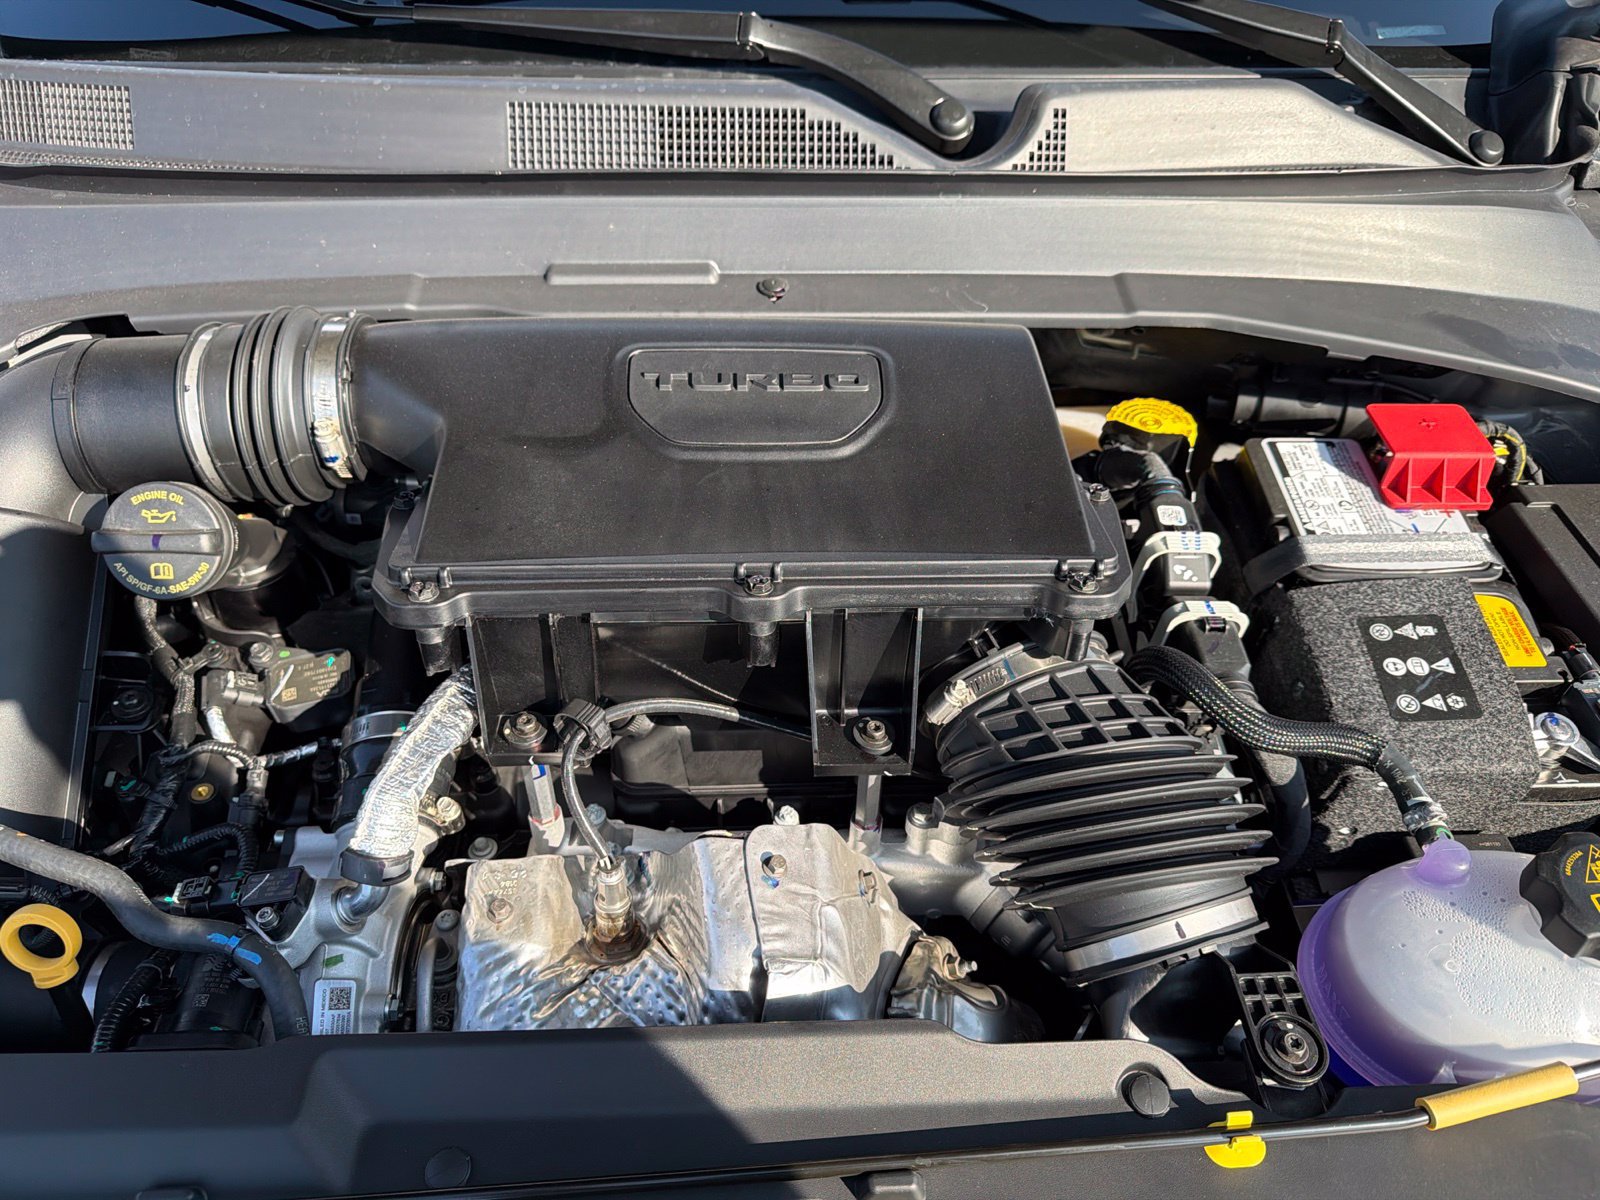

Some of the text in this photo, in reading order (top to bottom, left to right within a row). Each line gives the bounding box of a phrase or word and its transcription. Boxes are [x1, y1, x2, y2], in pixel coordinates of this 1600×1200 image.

[640, 372, 870, 392] TURBO
[131, 490, 184, 506] ENGINE OIL
[113, 561, 127, 578] API
